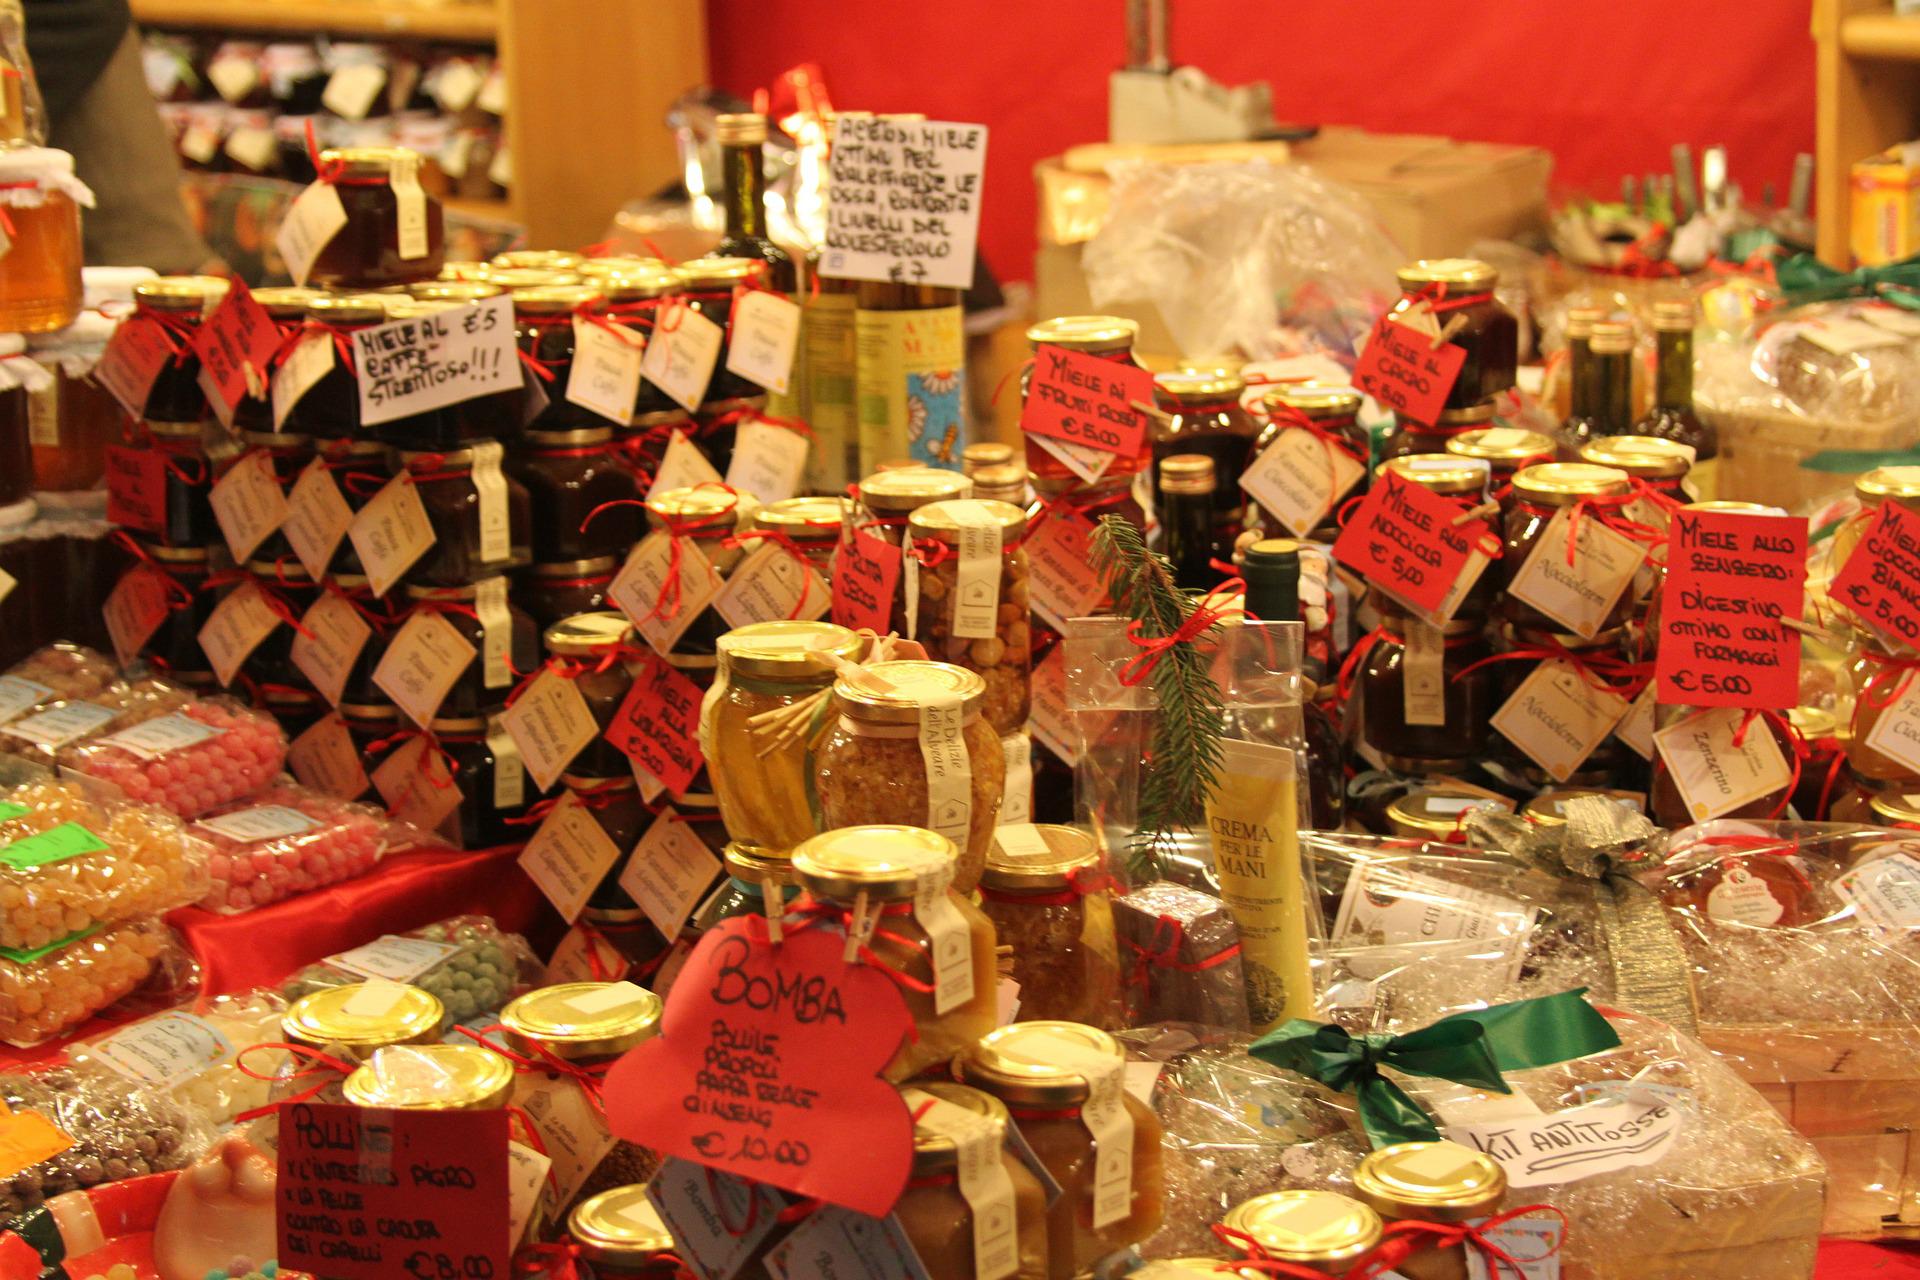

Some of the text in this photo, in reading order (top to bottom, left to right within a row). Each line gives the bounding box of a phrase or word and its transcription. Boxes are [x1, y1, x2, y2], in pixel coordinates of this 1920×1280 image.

[921, 128, 979, 149] MIELE
[903, 148, 941, 170] PER
[954, 173, 978, 193] LE
[913, 217, 951, 237] DEL
[358, 323, 417, 356] MIELE
[420, 316, 449, 338] AL
[1048, 351, 1103, 393] MIELE
[1383, 473, 1433, 533] MIELE
[1676, 513, 1796, 554] MIELE ALLO
[1680, 582, 1784, 619] DIGESTIVO
[1669, 618, 1732, 641] OTTIMO
[1742, 626, 1777, 643] CON
[1693, 641, 1780, 667] FORMAGGI
[944, 707, 963, 770] Le Delizie
[1692, 731, 1733, 796] Zenzerino
[1210, 815, 1275, 844] CREMA
[1245, 842, 1264, 859] LE
[1218, 854, 1268, 880] MANI
[708, 932, 847, 1026] BOMBA
[1468, 1105, 1672, 1163] KIT ANTITOSSE
[410, 1160, 477, 1190] PIGRO
